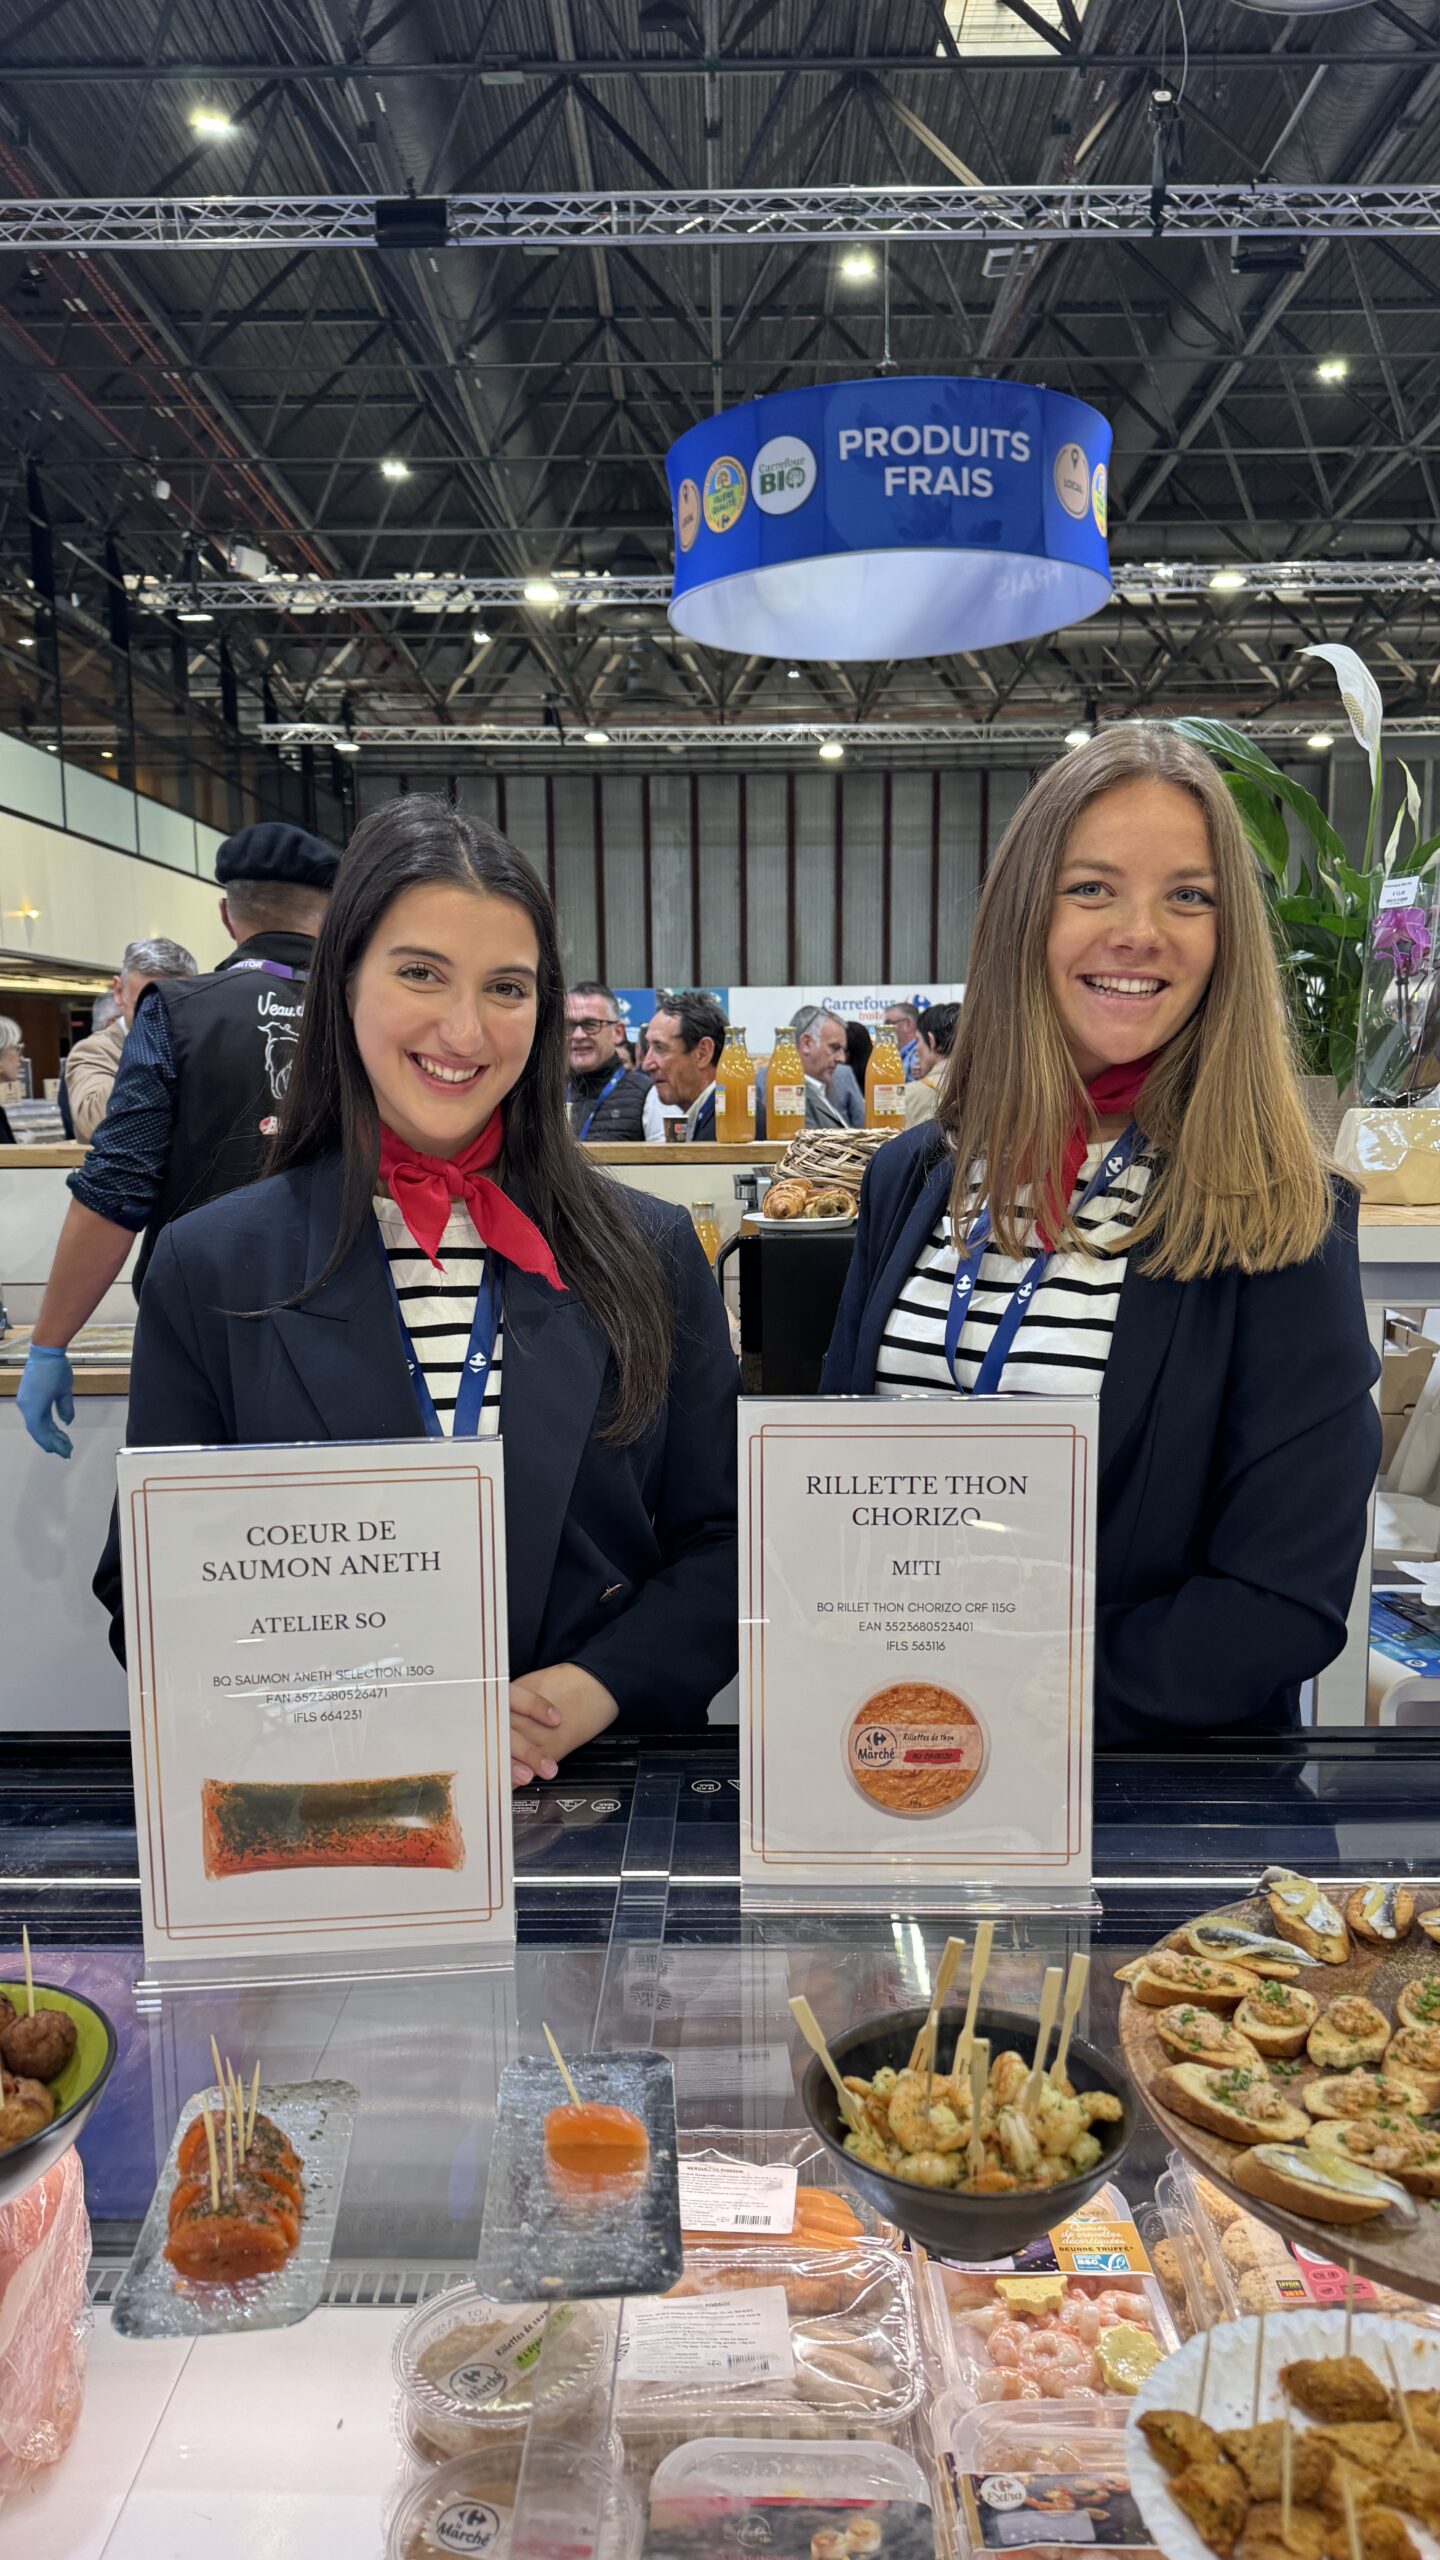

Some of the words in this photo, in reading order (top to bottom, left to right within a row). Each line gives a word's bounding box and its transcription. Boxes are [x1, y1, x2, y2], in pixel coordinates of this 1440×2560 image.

[838, 424, 1031, 463] PRODUITS
[758, 457, 806, 474] Carrefour
[759, 466, 806, 496] BIO
[883, 465, 994, 498] FRAIS
[821, 996, 896, 1011] Carrefour
[805, 1475, 938, 1495] RILLETTE
[945, 1475, 1028, 1495] THON
[852, 1507, 981, 1526] CHORIZO
[246, 1522, 351, 1547] COEUR
[357, 1520, 397, 1542] DE
[202, 1556, 332, 1582] SAUMON
[339, 1551, 441, 1576] ANETH
[891, 1560, 941, 1576] MITI
[816, 1602, 834, 1613] BQ
[837, 1602, 870, 1613] RILLET
[874, 1602, 904, 1613] THON
[907, 1602, 962, 1613] CHORIZO
[964, 1602, 988, 1613] CRF
[991, 1602, 1017, 1613] 115G
[250, 1613, 350, 1634] ATELIER
[355, 1612, 386, 1629] SO
[858, 1621, 881, 1632] EAN
[885, 1621, 974, 1632] 3523680523401
[886, 1641, 909, 1651] IFLS
[911, 1641, 946, 1651] 563116
[213, 1675, 232, 1687] BQ
[235, 1672, 290, 1685] SAUMON
[293, 1669, 332, 1683] ANETH
[335, 1666, 402, 1682] SELECTION
[406, 1665, 435, 1677] 130G
[294, 1711, 317, 1724] IFLS
[320, 1709, 362, 1722] 664231
[903, 1733, 929, 1741] Rillettes
[931, 1733, 939, 1741] de
[857, 1747, 896, 1760] Marché
[465, 2369, 506, 2400] Marché
[436, 2522, 491, 2547] Marché
